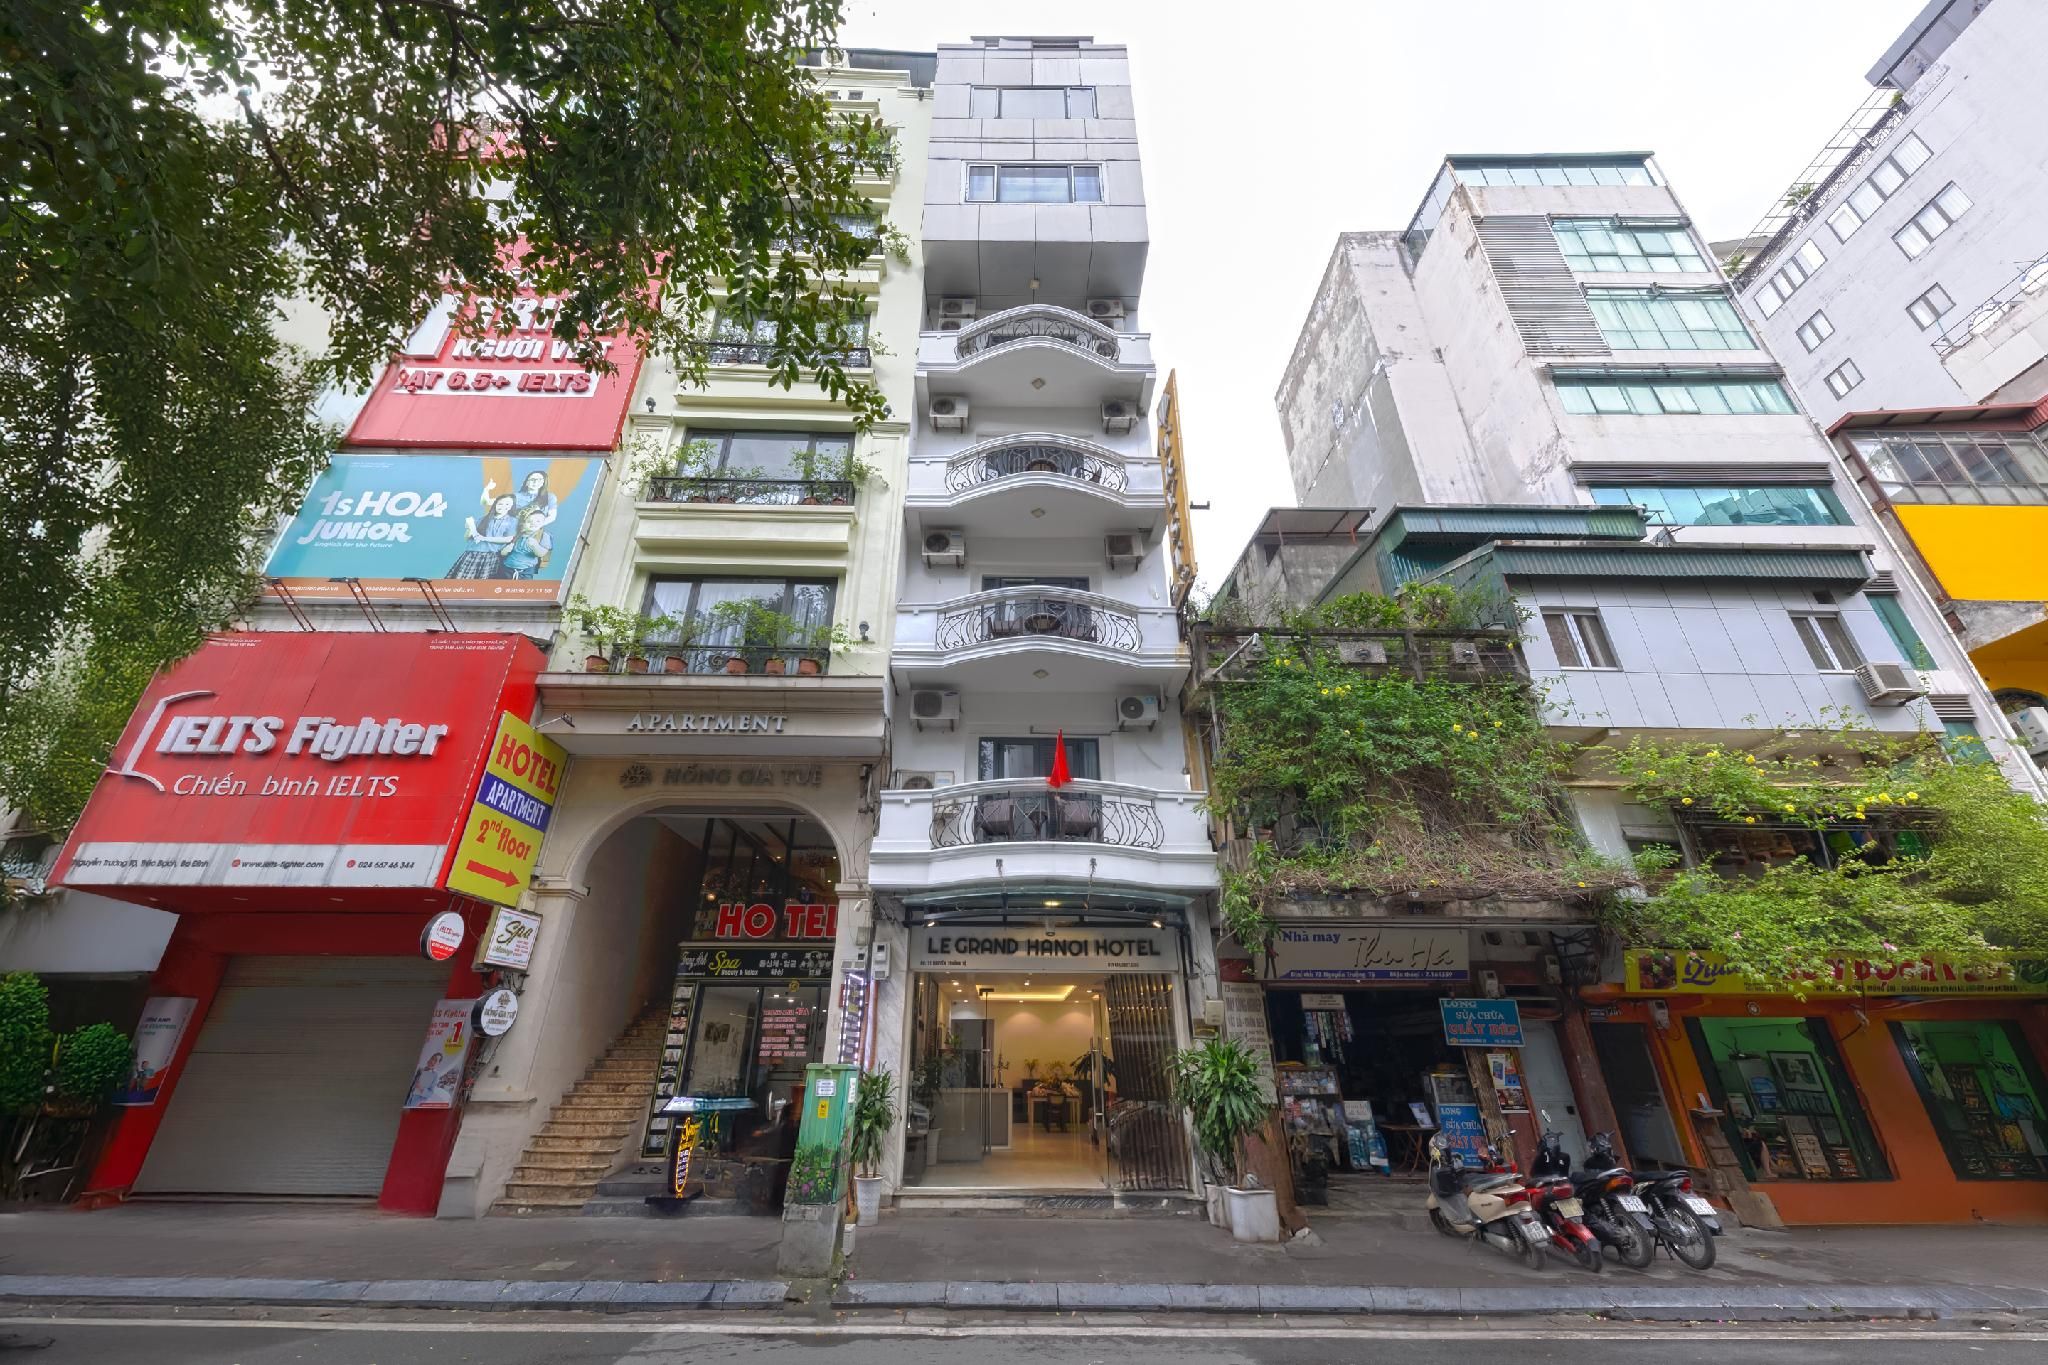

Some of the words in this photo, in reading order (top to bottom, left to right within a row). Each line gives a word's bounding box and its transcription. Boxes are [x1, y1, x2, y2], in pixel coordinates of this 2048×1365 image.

[447, 371, 510, 391] 6.5+
[517, 372, 591, 393] IELTS
[626, 713, 788, 733] APARTMENT
[155, 716, 284, 755] IELTS
[285, 716, 448, 762] Fighter
[496, 733, 557, 795] HOTEL
[173, 772, 247, 796] Chiến
[325, 776, 399, 797] IELTS
[486, 780, 546, 827] APARTMENT
[497, 828, 532, 861] floor
[928, 937, 950, 954] LE
[955, 938, 1018, 955] GRAND
[1096, 940, 1161, 957] HOTEL
[708, 951, 742, 976] Spa
[1443, 1000, 1477, 1008] LONG
